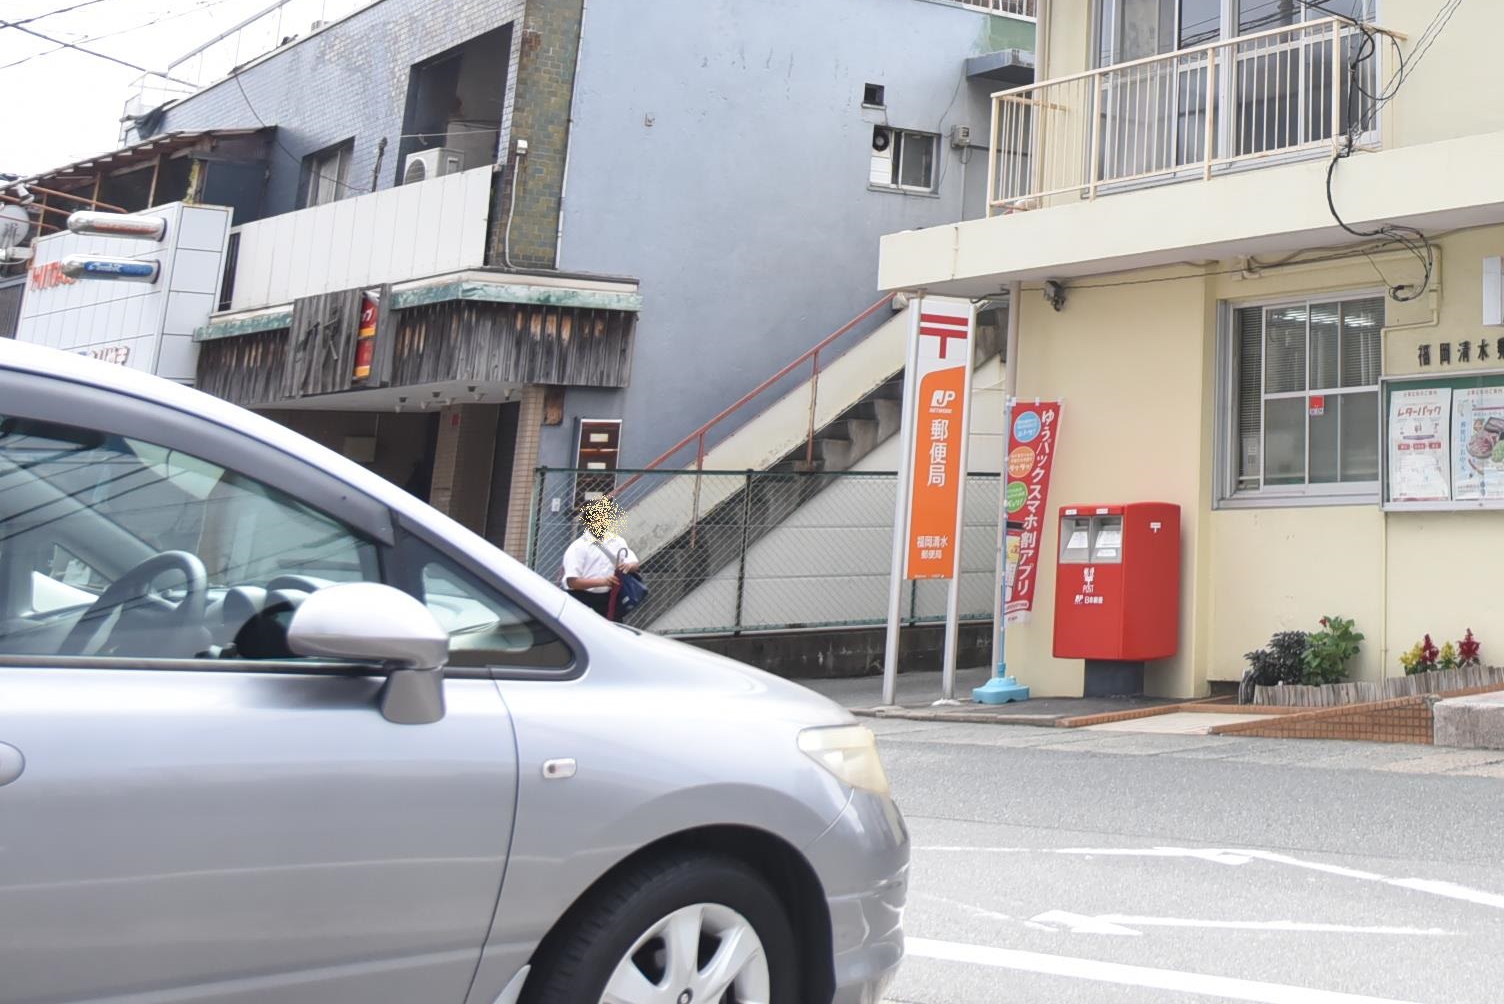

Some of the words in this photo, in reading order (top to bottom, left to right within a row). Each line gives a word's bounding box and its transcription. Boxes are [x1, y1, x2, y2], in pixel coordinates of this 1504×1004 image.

[1397, 404, 1442, 416] レターパック
[928, 418, 949, 487] 郵便局
[1016, 409, 1055, 597] ゆうパックスマホ割アプリ
[916, 534, 949, 548] 福岡清水
[920, 549, 944, 561] 郵便局
